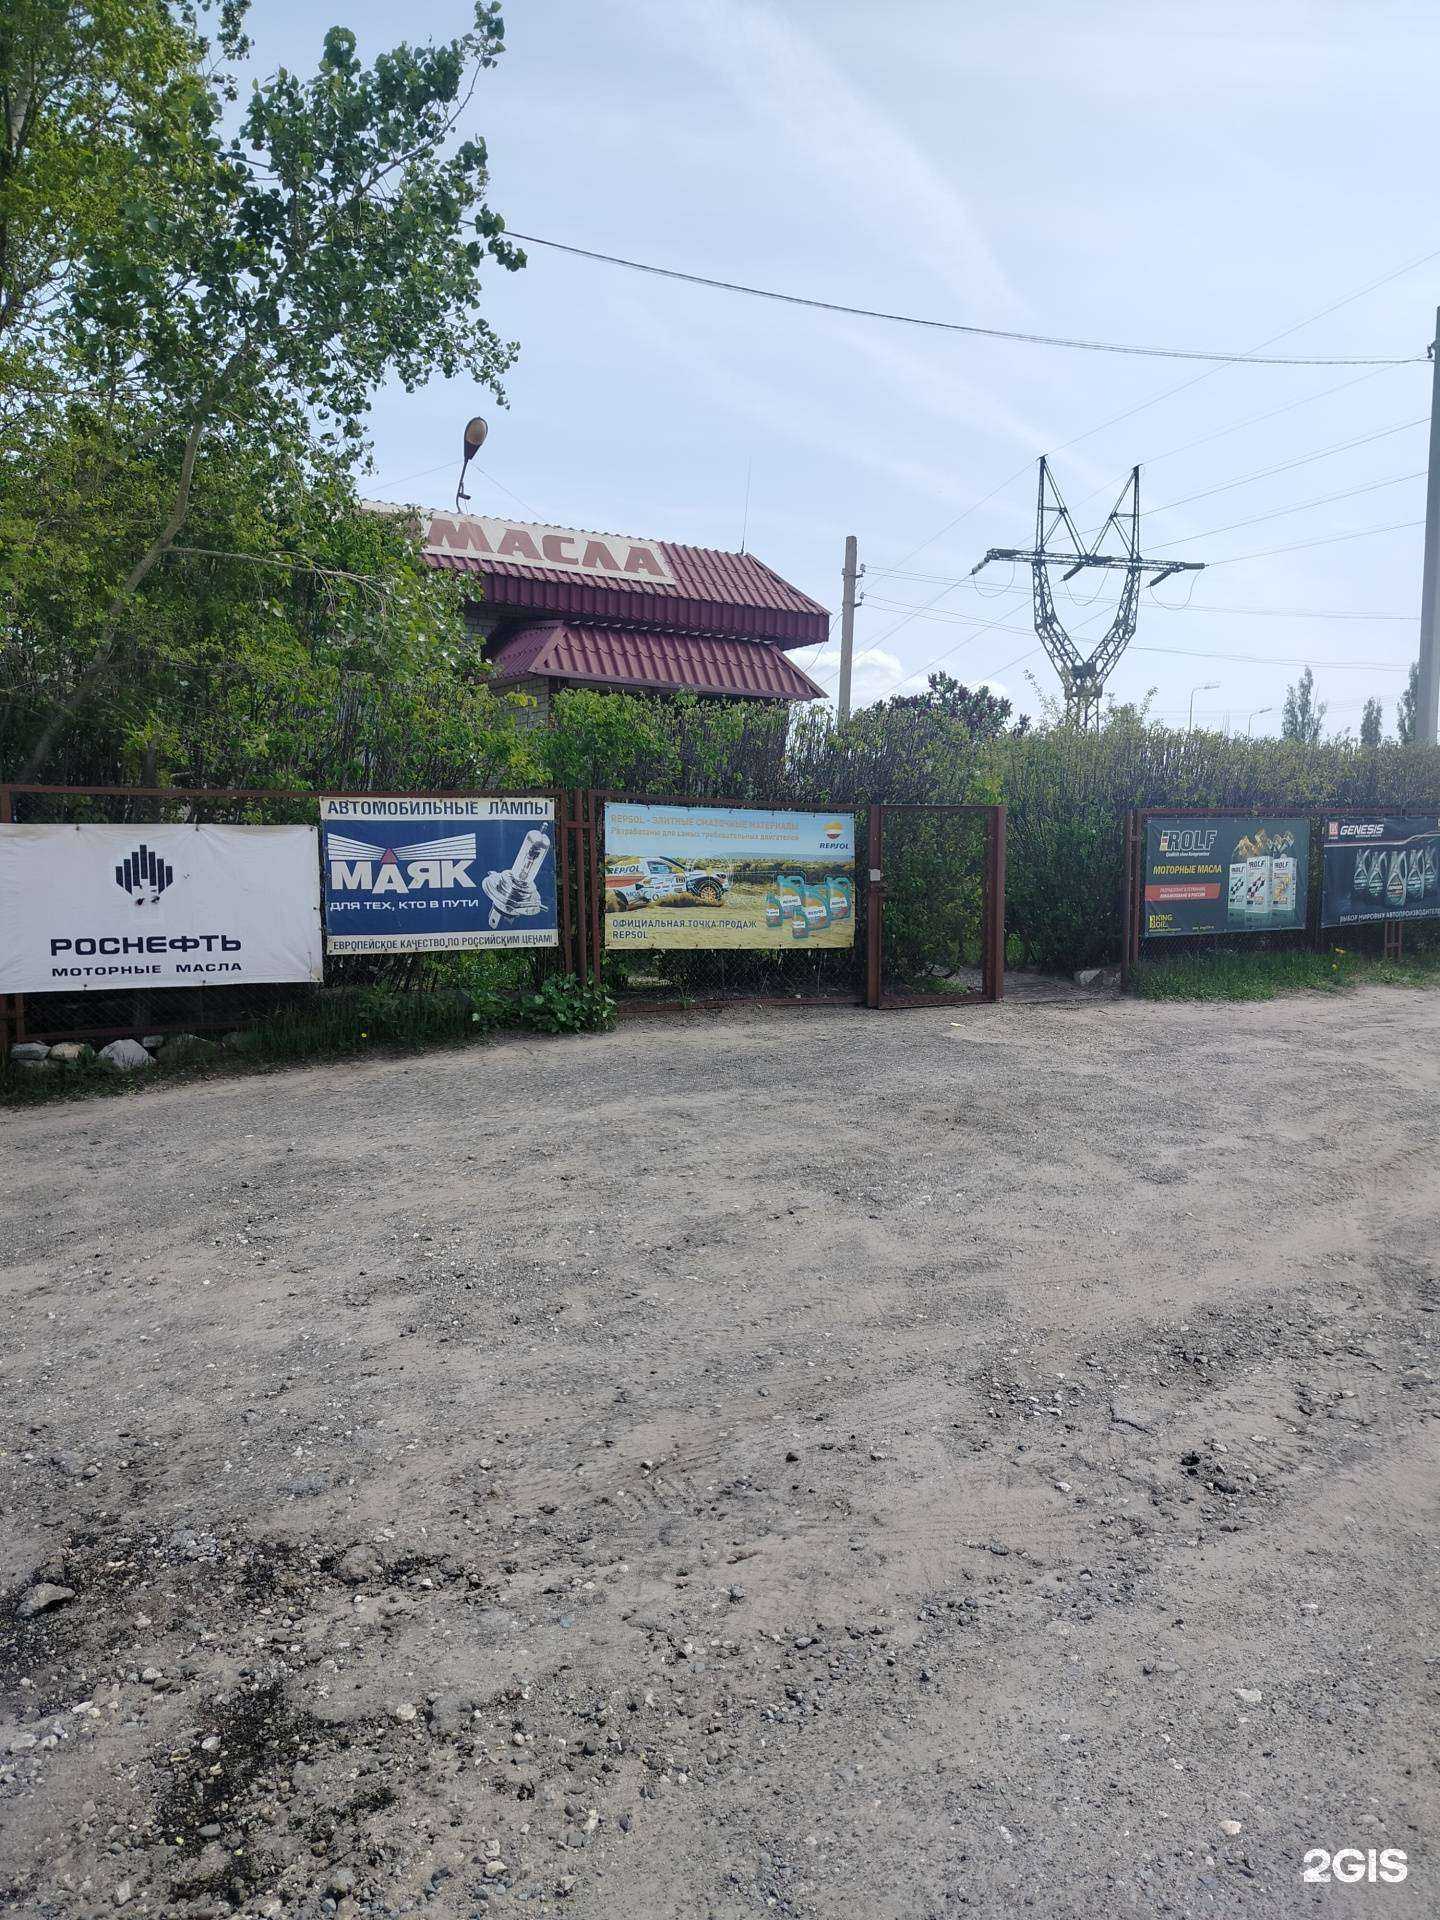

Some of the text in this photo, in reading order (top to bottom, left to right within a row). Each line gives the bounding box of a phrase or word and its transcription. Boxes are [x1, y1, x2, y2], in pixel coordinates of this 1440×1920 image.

[328, 801, 549, 815] АВТОМОБИЛЬНЫЕ ЛАМПЫ
[1340, 823, 1384, 835] GENESIS
[819, 842, 849, 850] REPSOL
[1162, 830, 1218, 851] ROLF
[330, 852, 477, 894] МАЯК
[1153, 864, 1222, 875] МОТОРНЫЕ МАСЛА
[330, 899, 479, 912] ДЛЯ ТЕХ, КТО В ПУТИ
[612, 919, 757, 930] ОФИЦИАЛЬНАЯ ТОЧКА ПРОДАЖ
[612, 930, 648, 939] REPSOL
[50, 935, 242, 956] РОСНЕФТЬ
[334, 939, 397, 950] ЕВРОПЕЙСКОЕ
[400, 938, 445, 948] КАЧЕСТВО
[448, 937, 459, 947] ПО
[462, 935, 519, 946] РОССИЙСКИМ
[52, 963, 242, 977] МОТОРНЫЕ МАСЛА
